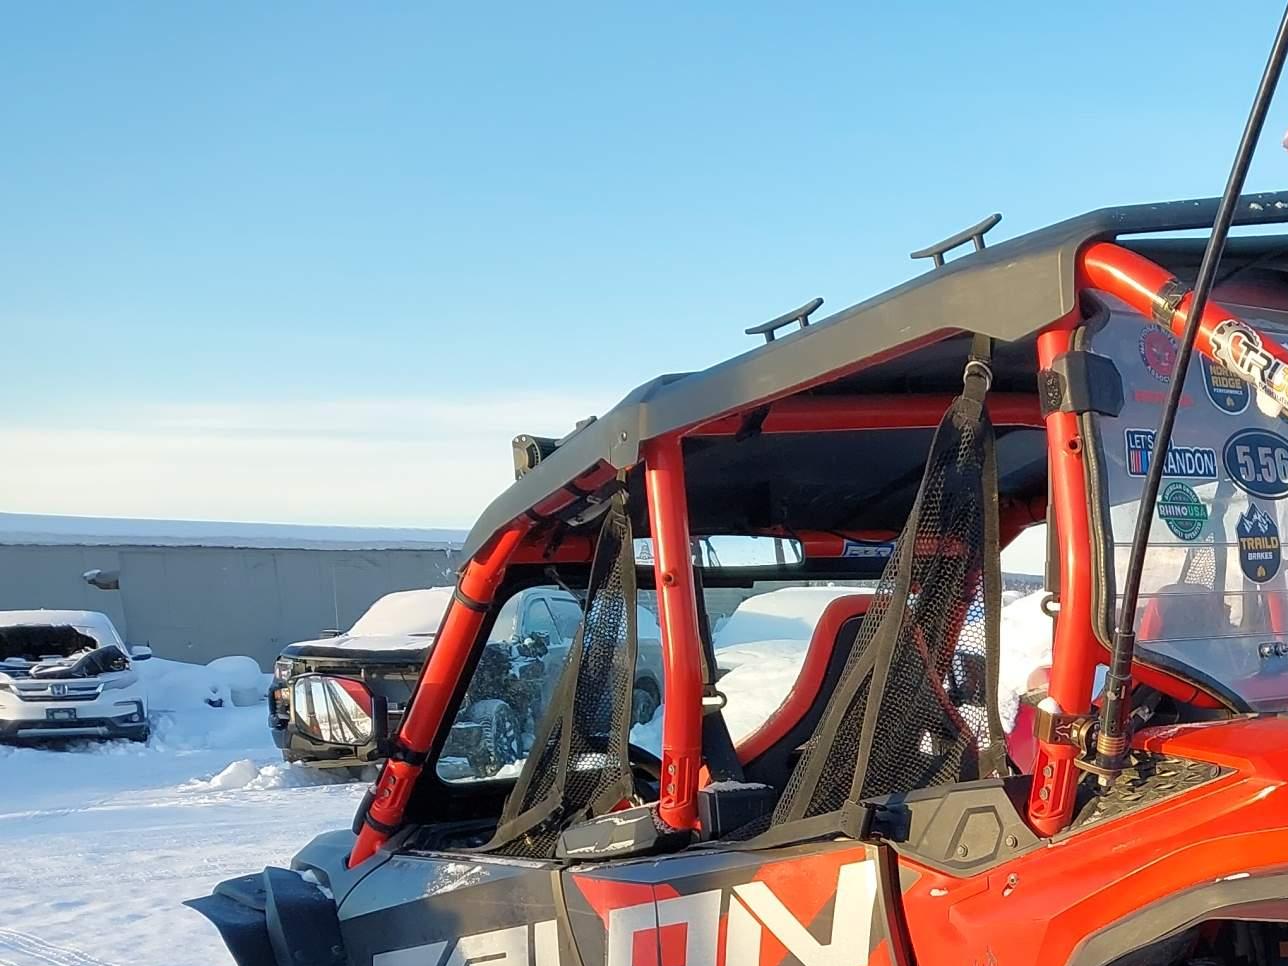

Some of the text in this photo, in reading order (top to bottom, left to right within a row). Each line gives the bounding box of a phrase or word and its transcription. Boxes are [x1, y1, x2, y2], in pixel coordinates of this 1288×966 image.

[1211, 376, 1242, 389] RIDGE
[1129, 432, 1154, 449] LET'S
[1248, 551, 1273, 560] BRAKES
